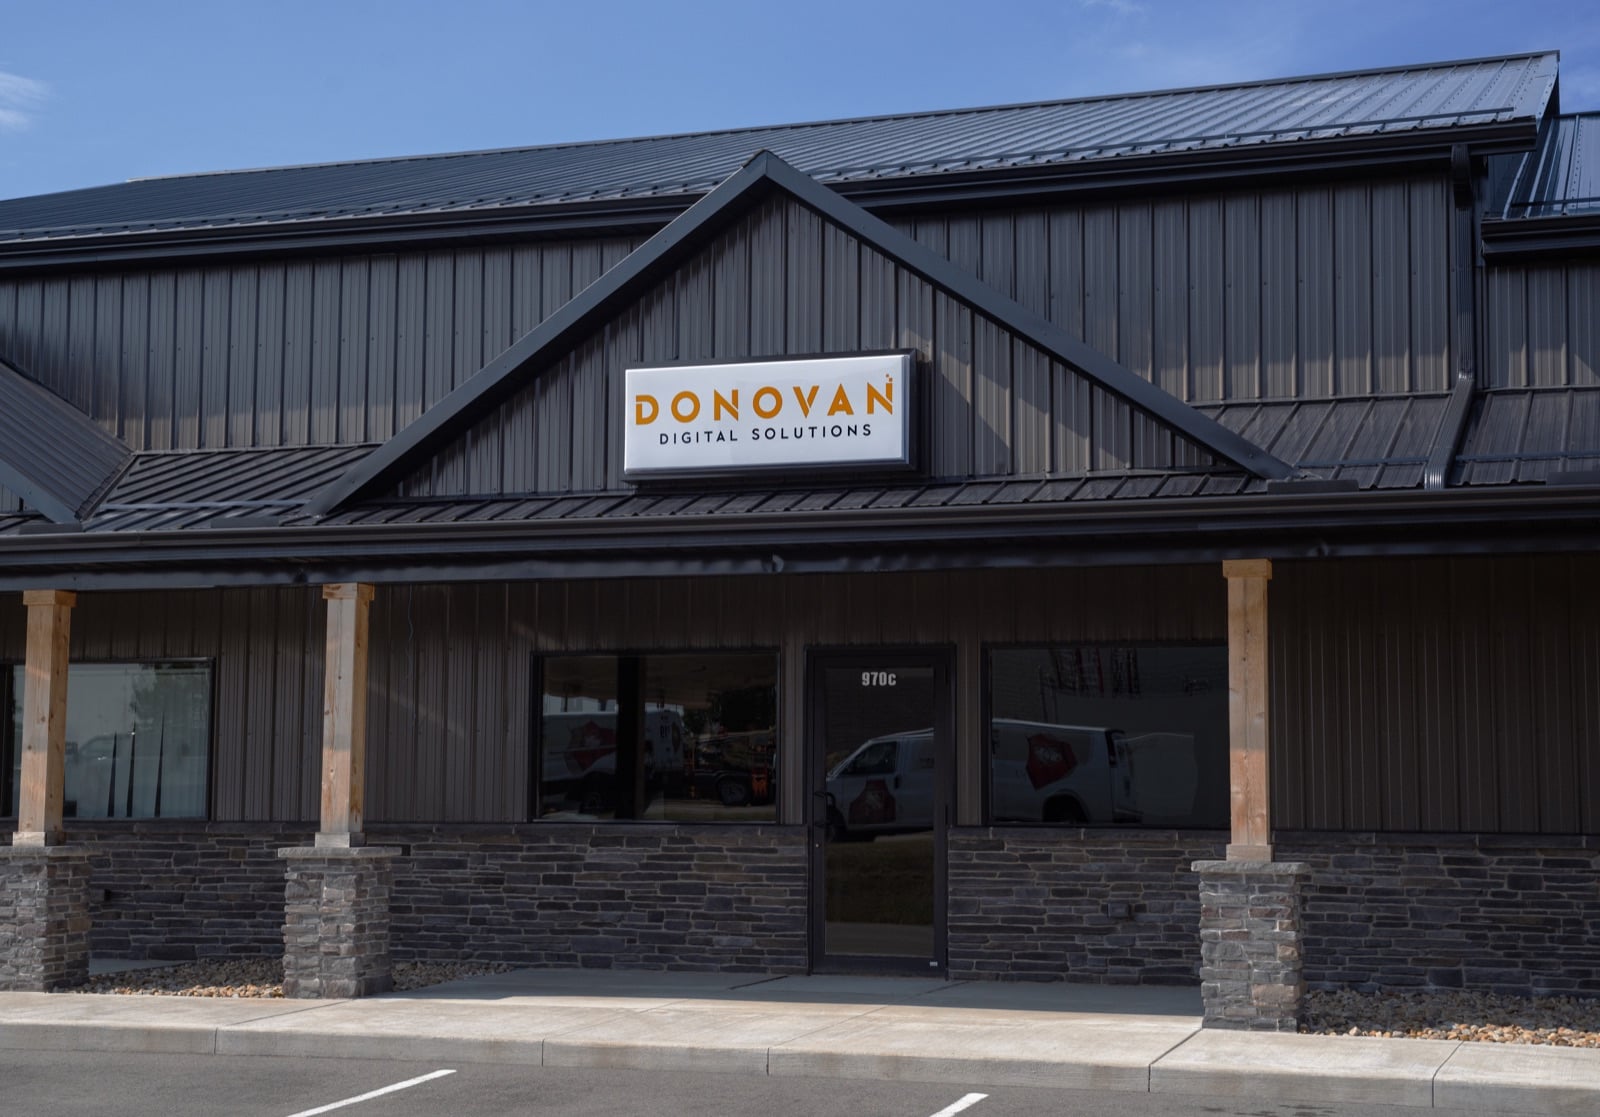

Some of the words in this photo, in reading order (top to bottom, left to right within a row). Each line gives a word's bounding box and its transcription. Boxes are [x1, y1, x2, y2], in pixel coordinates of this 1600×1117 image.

[635, 374, 894, 425] DONOVAN
[659, 430, 739, 445] DIGITAL
[751, 424, 872, 441] SOLUTIONS
